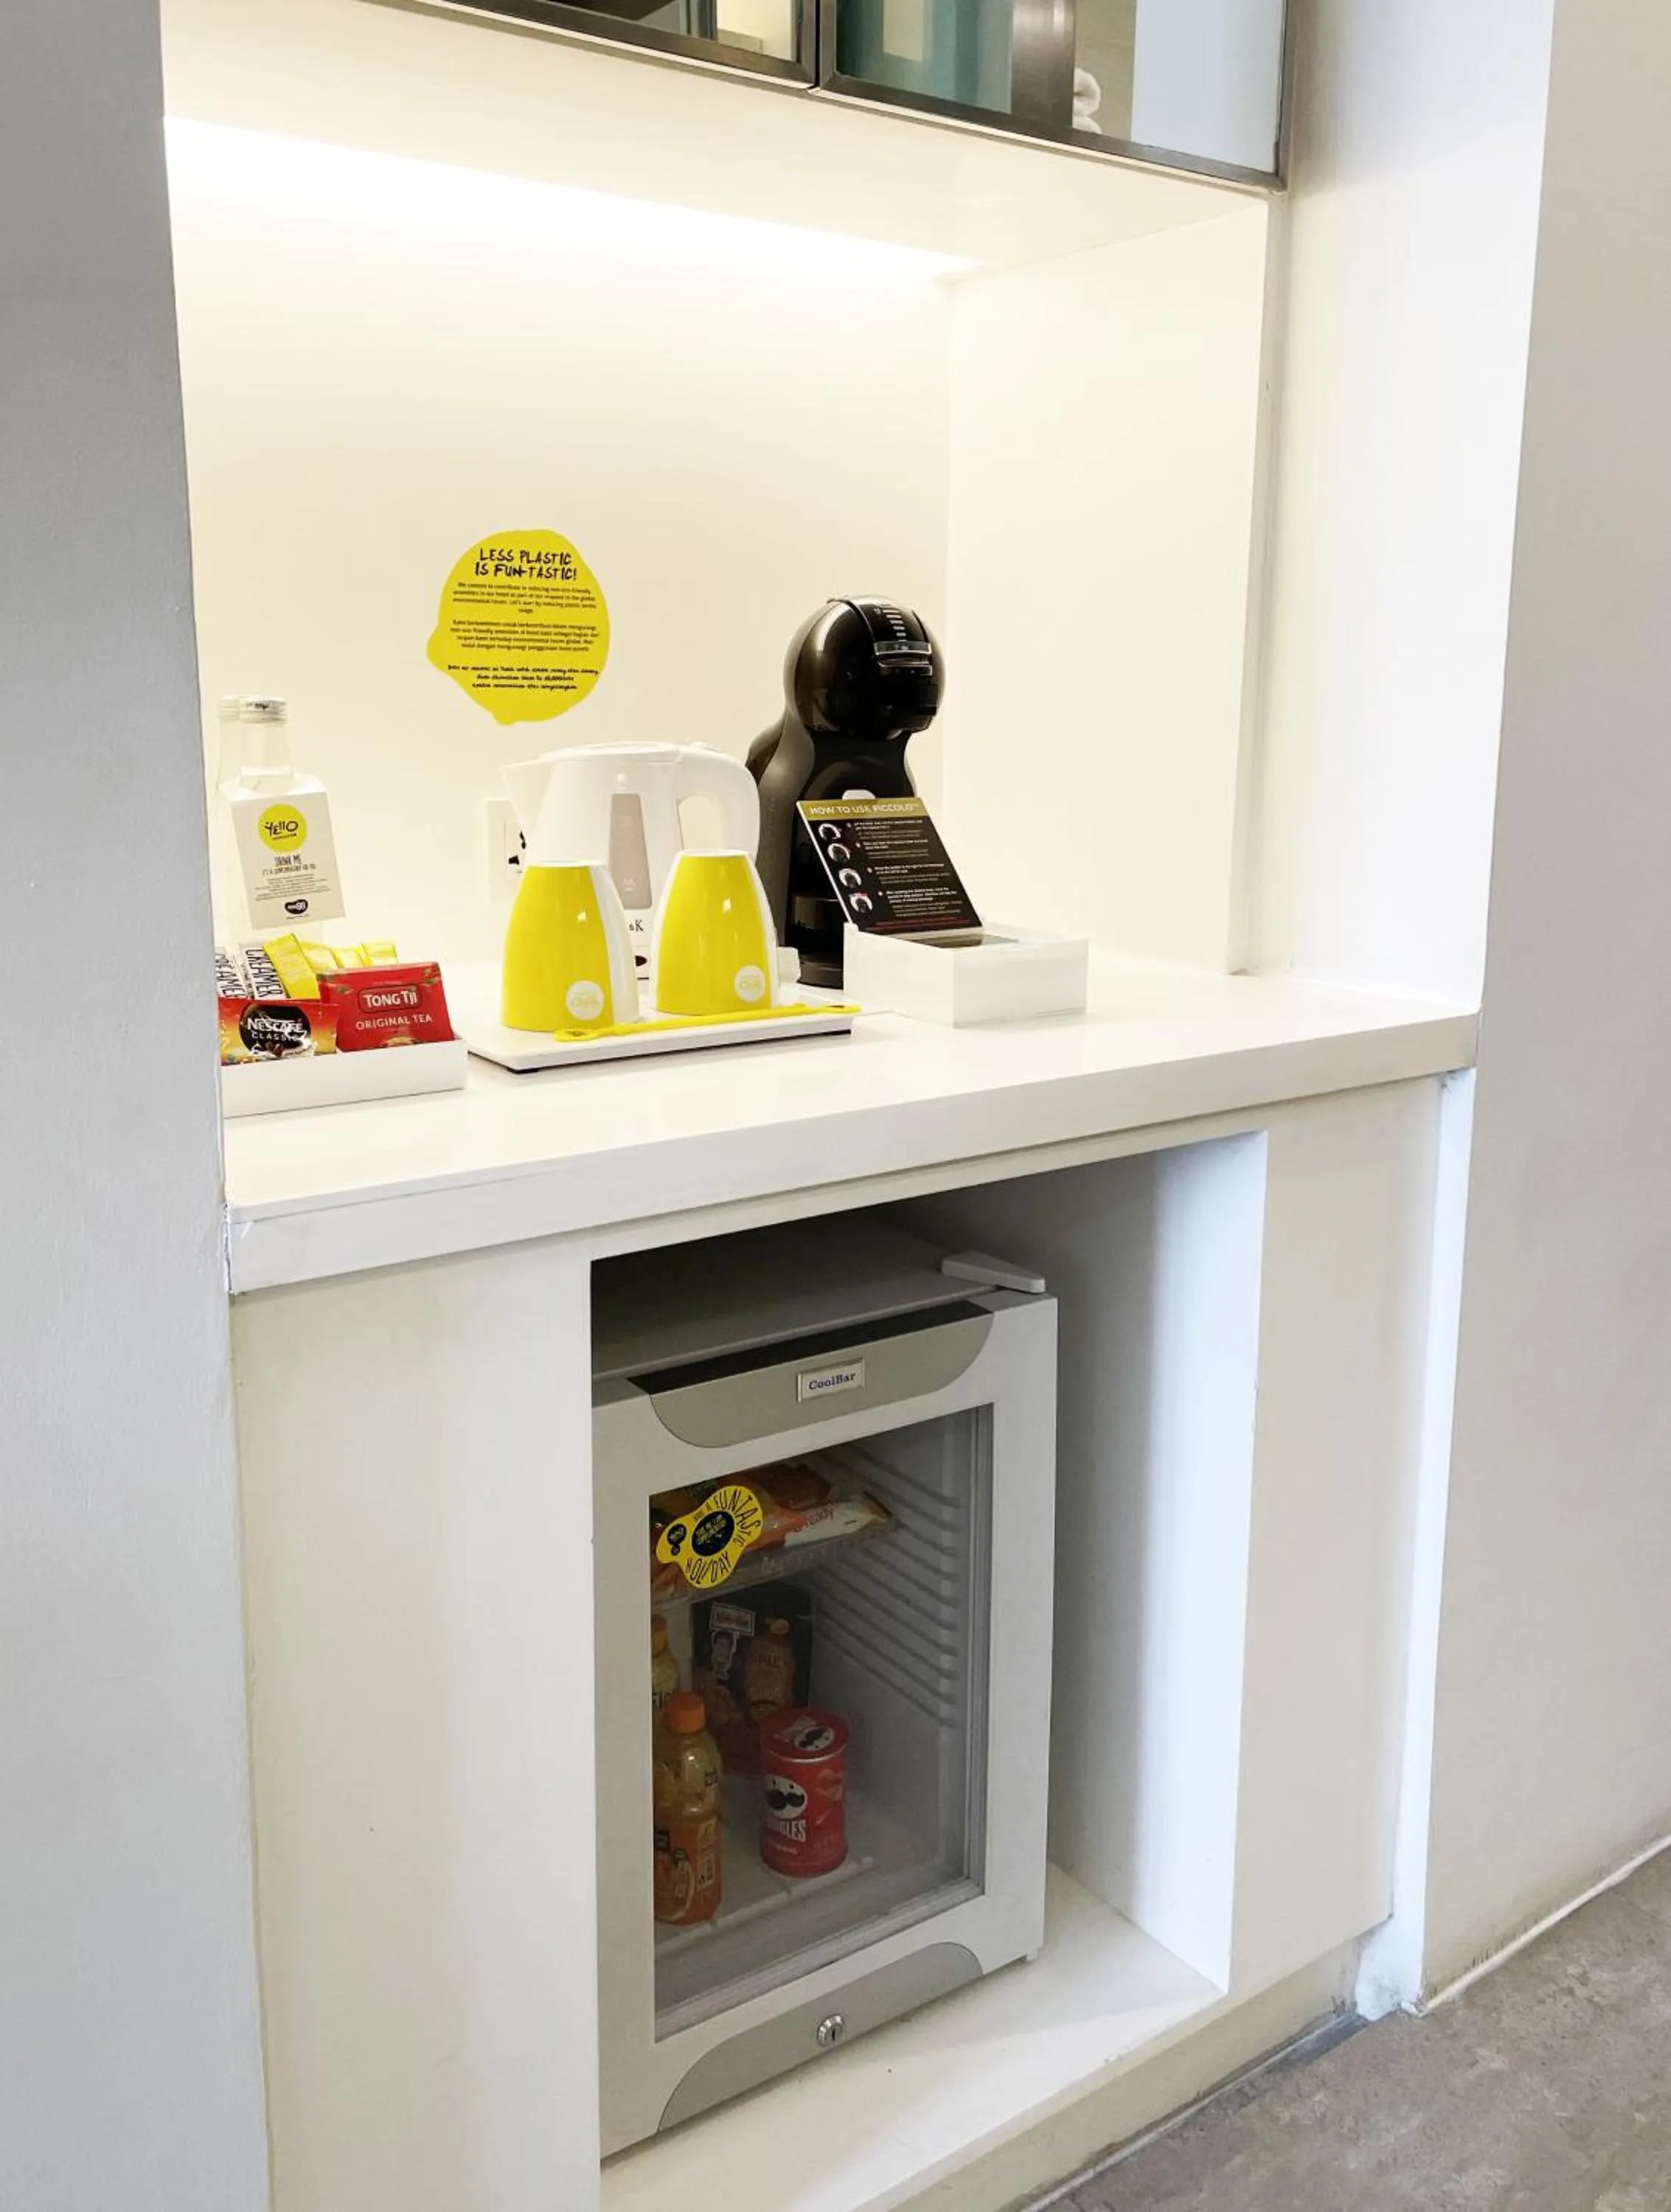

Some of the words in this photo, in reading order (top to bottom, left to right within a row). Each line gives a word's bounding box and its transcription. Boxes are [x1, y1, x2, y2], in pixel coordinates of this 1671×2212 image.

[479, 548, 514, 561] LESS
[519, 549, 572, 566] PLASTIC
[474, 561, 489, 576] IS
[493, 563, 577, 581] FUN-TASTIC!
[810, 806, 835, 815] HOW
[836, 805, 850, 813] TO
[246, 949, 284, 998] CREAMER
[364, 992, 400, 1008] TONG
[355, 1015, 411, 1031] ORIGINAL
[411, 1013, 434, 1023] TEA
[808, 1372, 856, 1391] CoolBar
